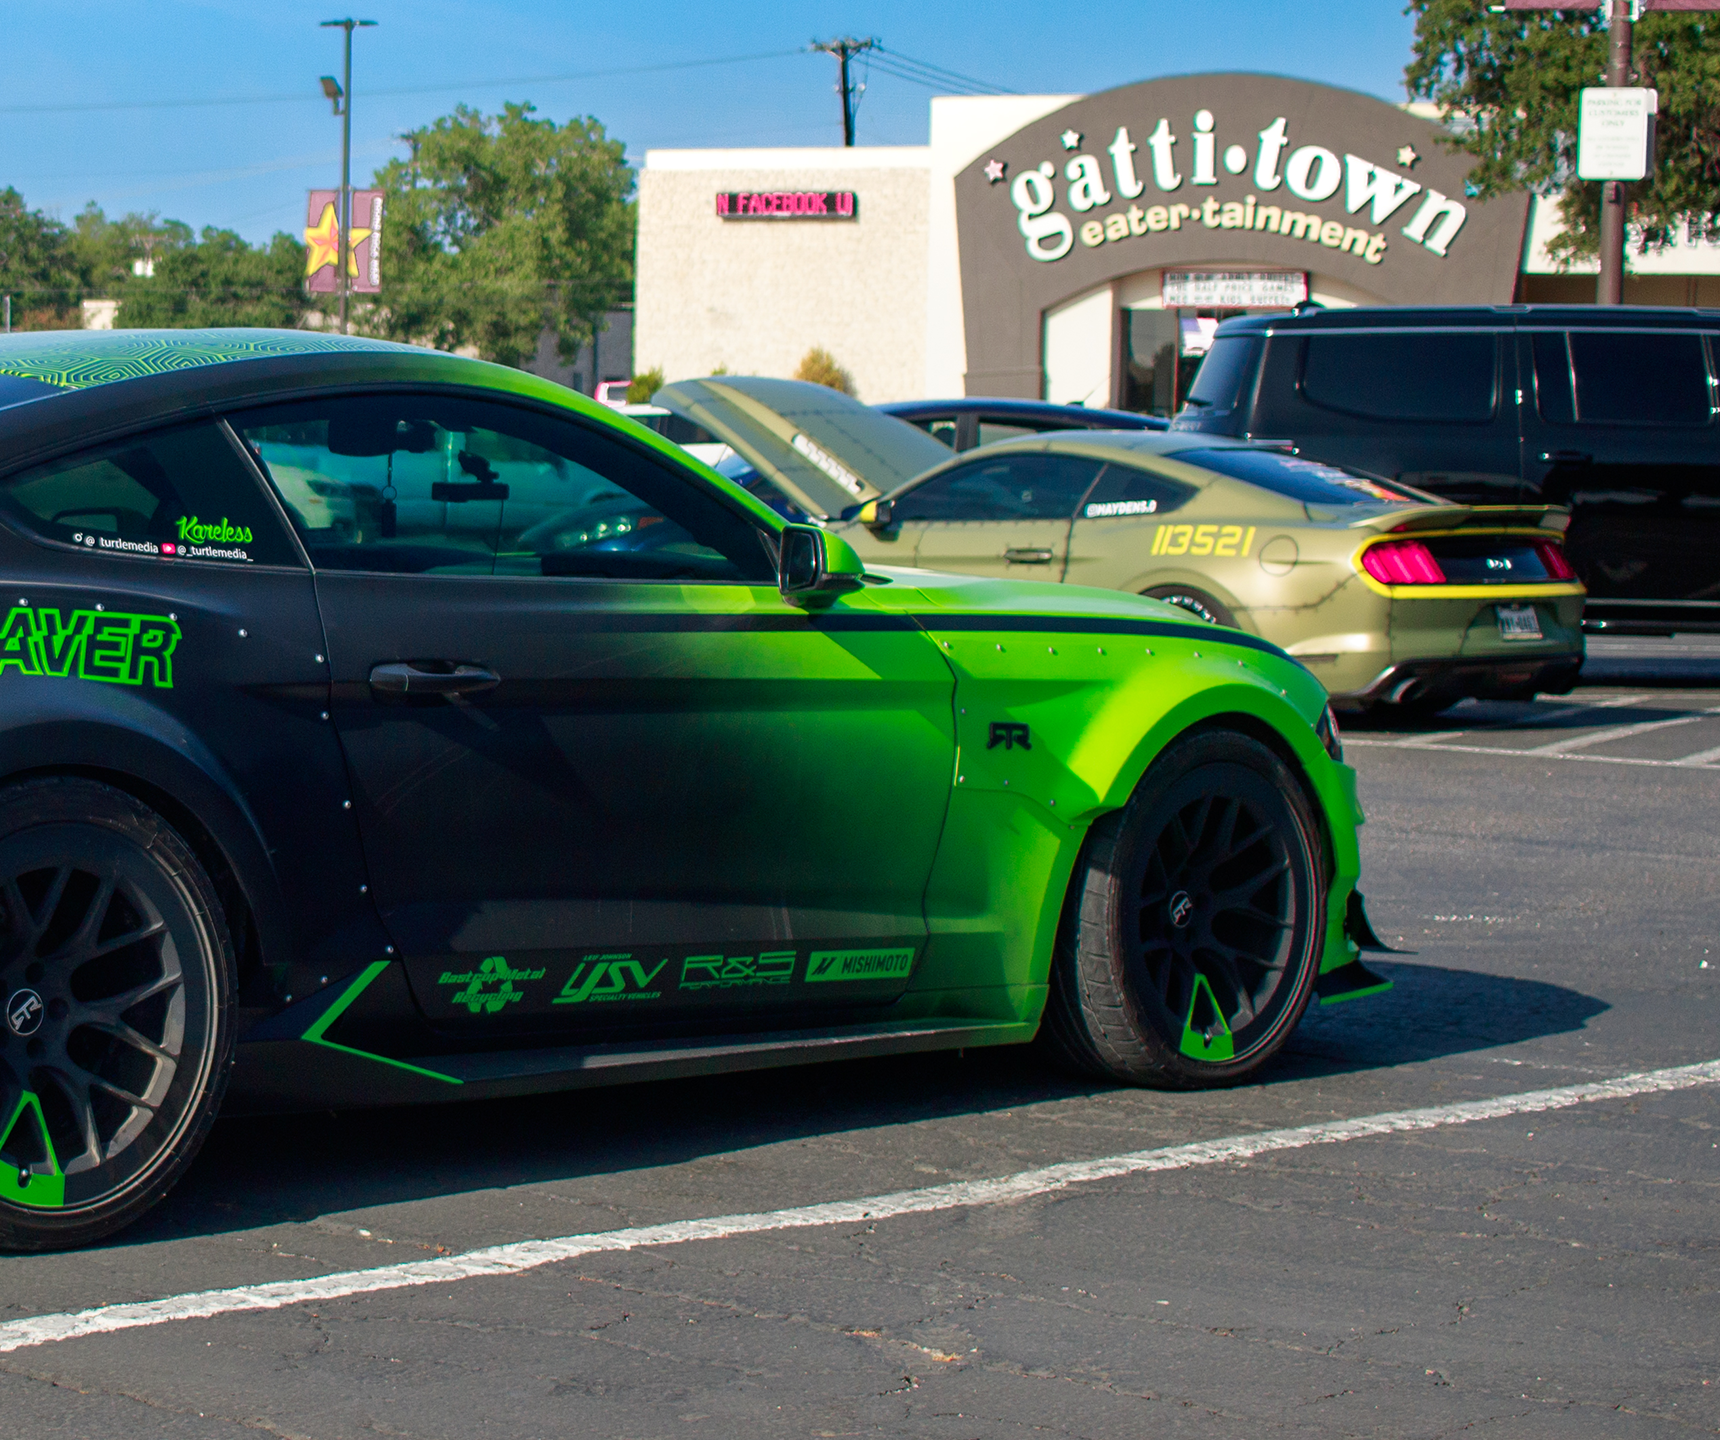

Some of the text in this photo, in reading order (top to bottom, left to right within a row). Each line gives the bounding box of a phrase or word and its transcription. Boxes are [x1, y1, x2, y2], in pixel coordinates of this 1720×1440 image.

[737, 192, 828, 215] FACEBOOK
[175, 516, 253, 544] Kareless
[1151, 525, 1256, 557] 113521
[681, 950, 797, 983] R&S
[841, 953, 909, 974] MISHIMOTO
[679, 976, 791, 990] PERFORMANCE
[451, 990, 524, 1003] Recycling
